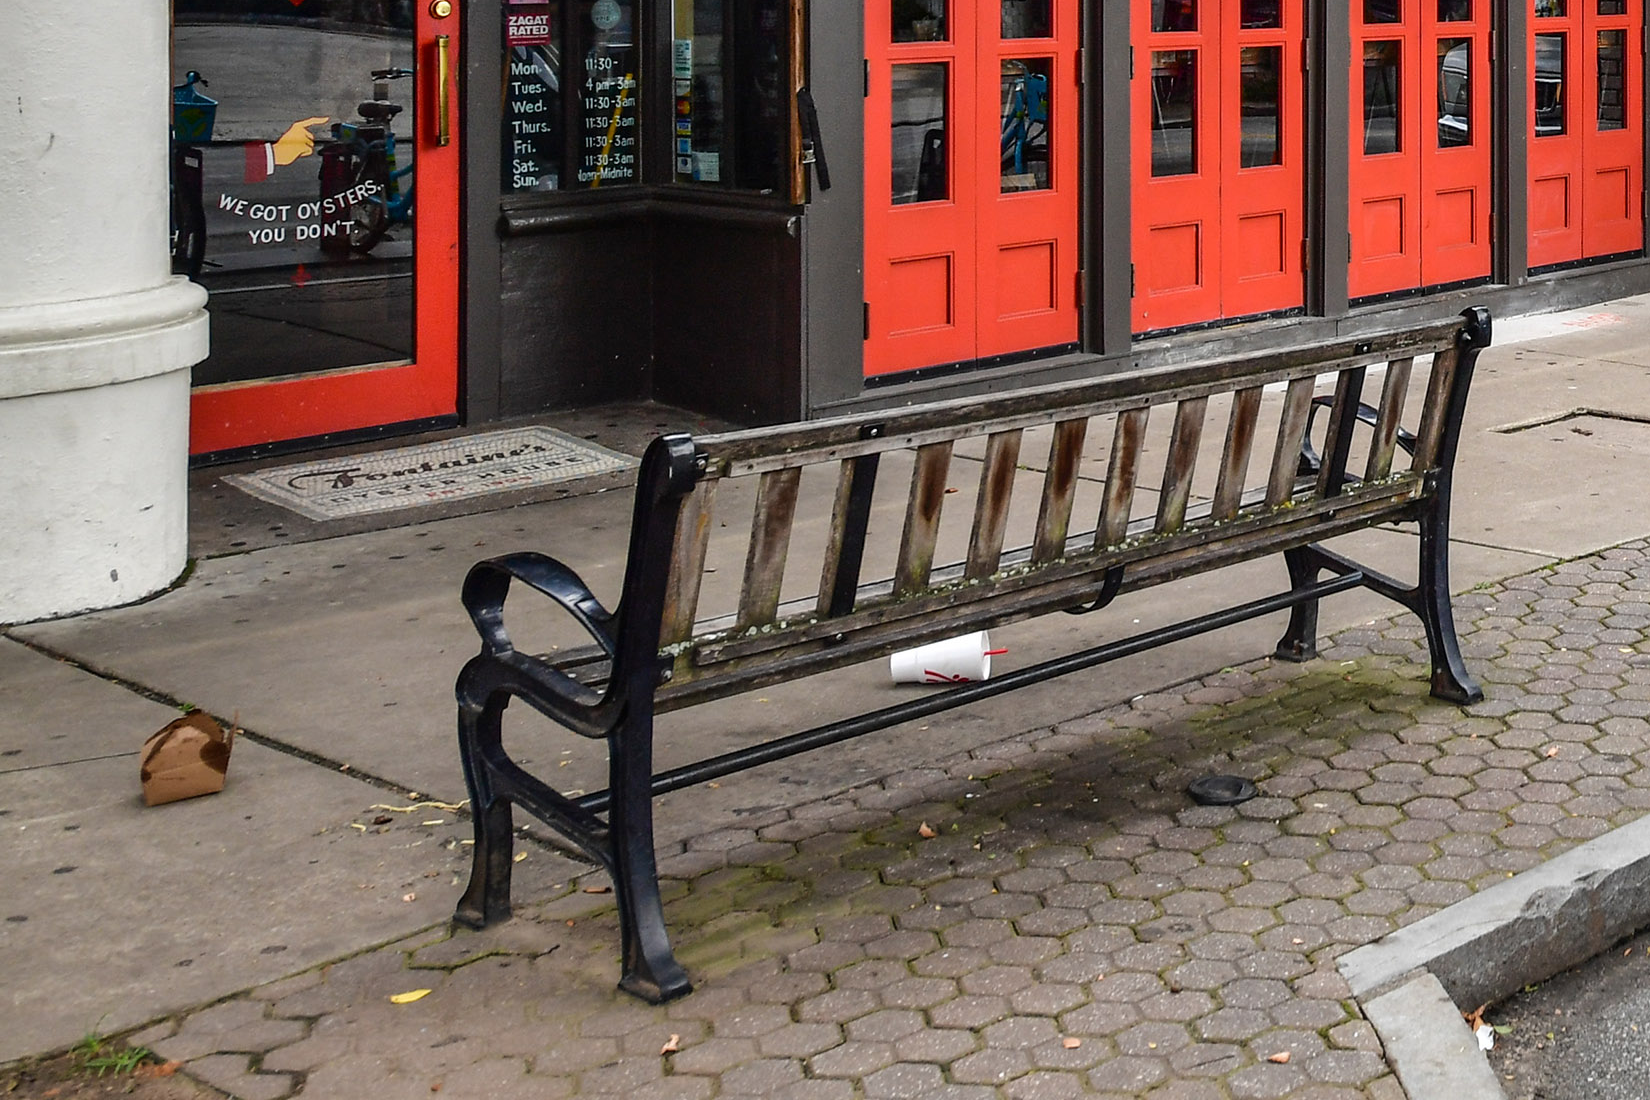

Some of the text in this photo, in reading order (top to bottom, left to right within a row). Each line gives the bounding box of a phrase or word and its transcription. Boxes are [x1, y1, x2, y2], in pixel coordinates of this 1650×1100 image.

[509, 15, 549, 25] ZAGAT
[508, 25, 549, 36] RATED
[511, 62, 543, 76] Mon.
[512, 81, 547, 95] Tues.
[512, 100, 548, 114] Wed.
[511, 120, 551, 134] Thurs.
[513, 140, 537, 154] Fri.
[512, 159, 540, 175] Sat.
[512, 174, 540, 189] Sun.
[218, 193, 249, 216] WE
[249, 203, 291, 223] GOT
[248, 219, 360, 245] YOU DON'T.
[288, 443, 547, 490] Fontaine's
